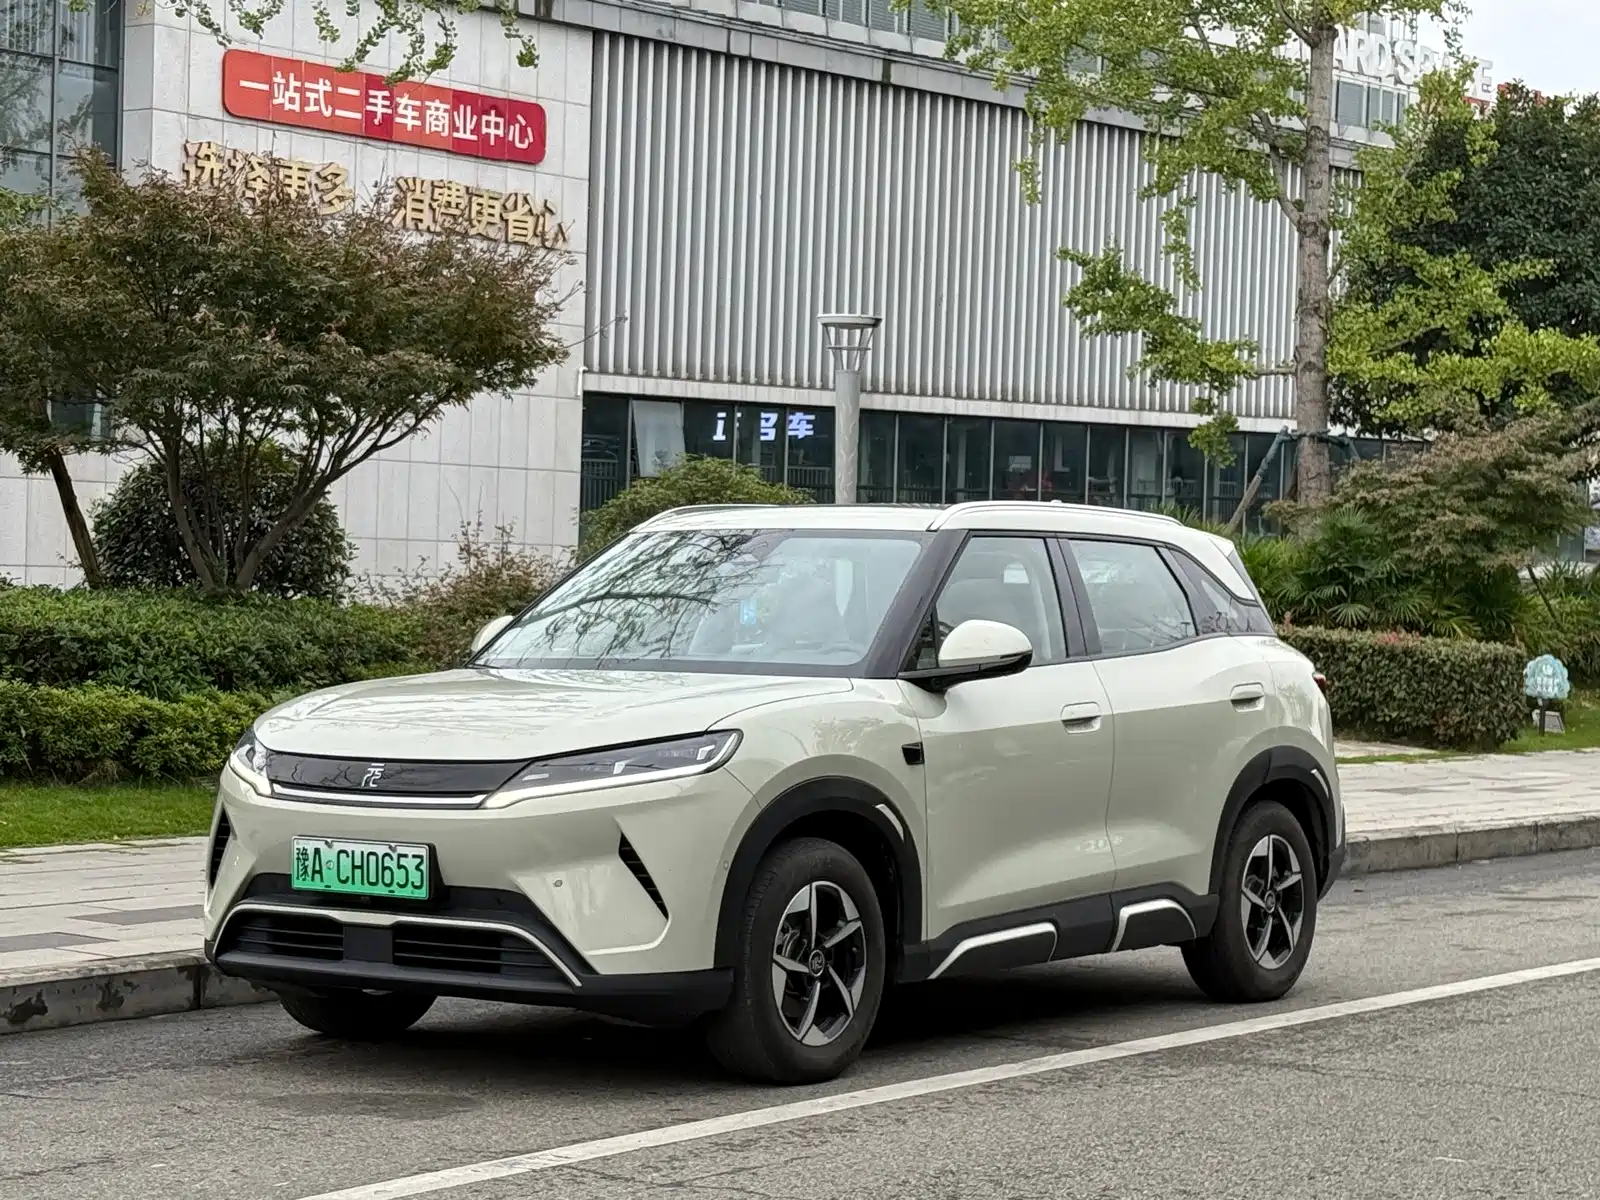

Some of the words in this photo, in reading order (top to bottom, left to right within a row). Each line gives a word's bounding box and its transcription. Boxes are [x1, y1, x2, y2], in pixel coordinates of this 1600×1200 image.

[238, 70, 535, 150] 一站式二手车商业中心
[392, 177, 570, 250] 消费更省心
